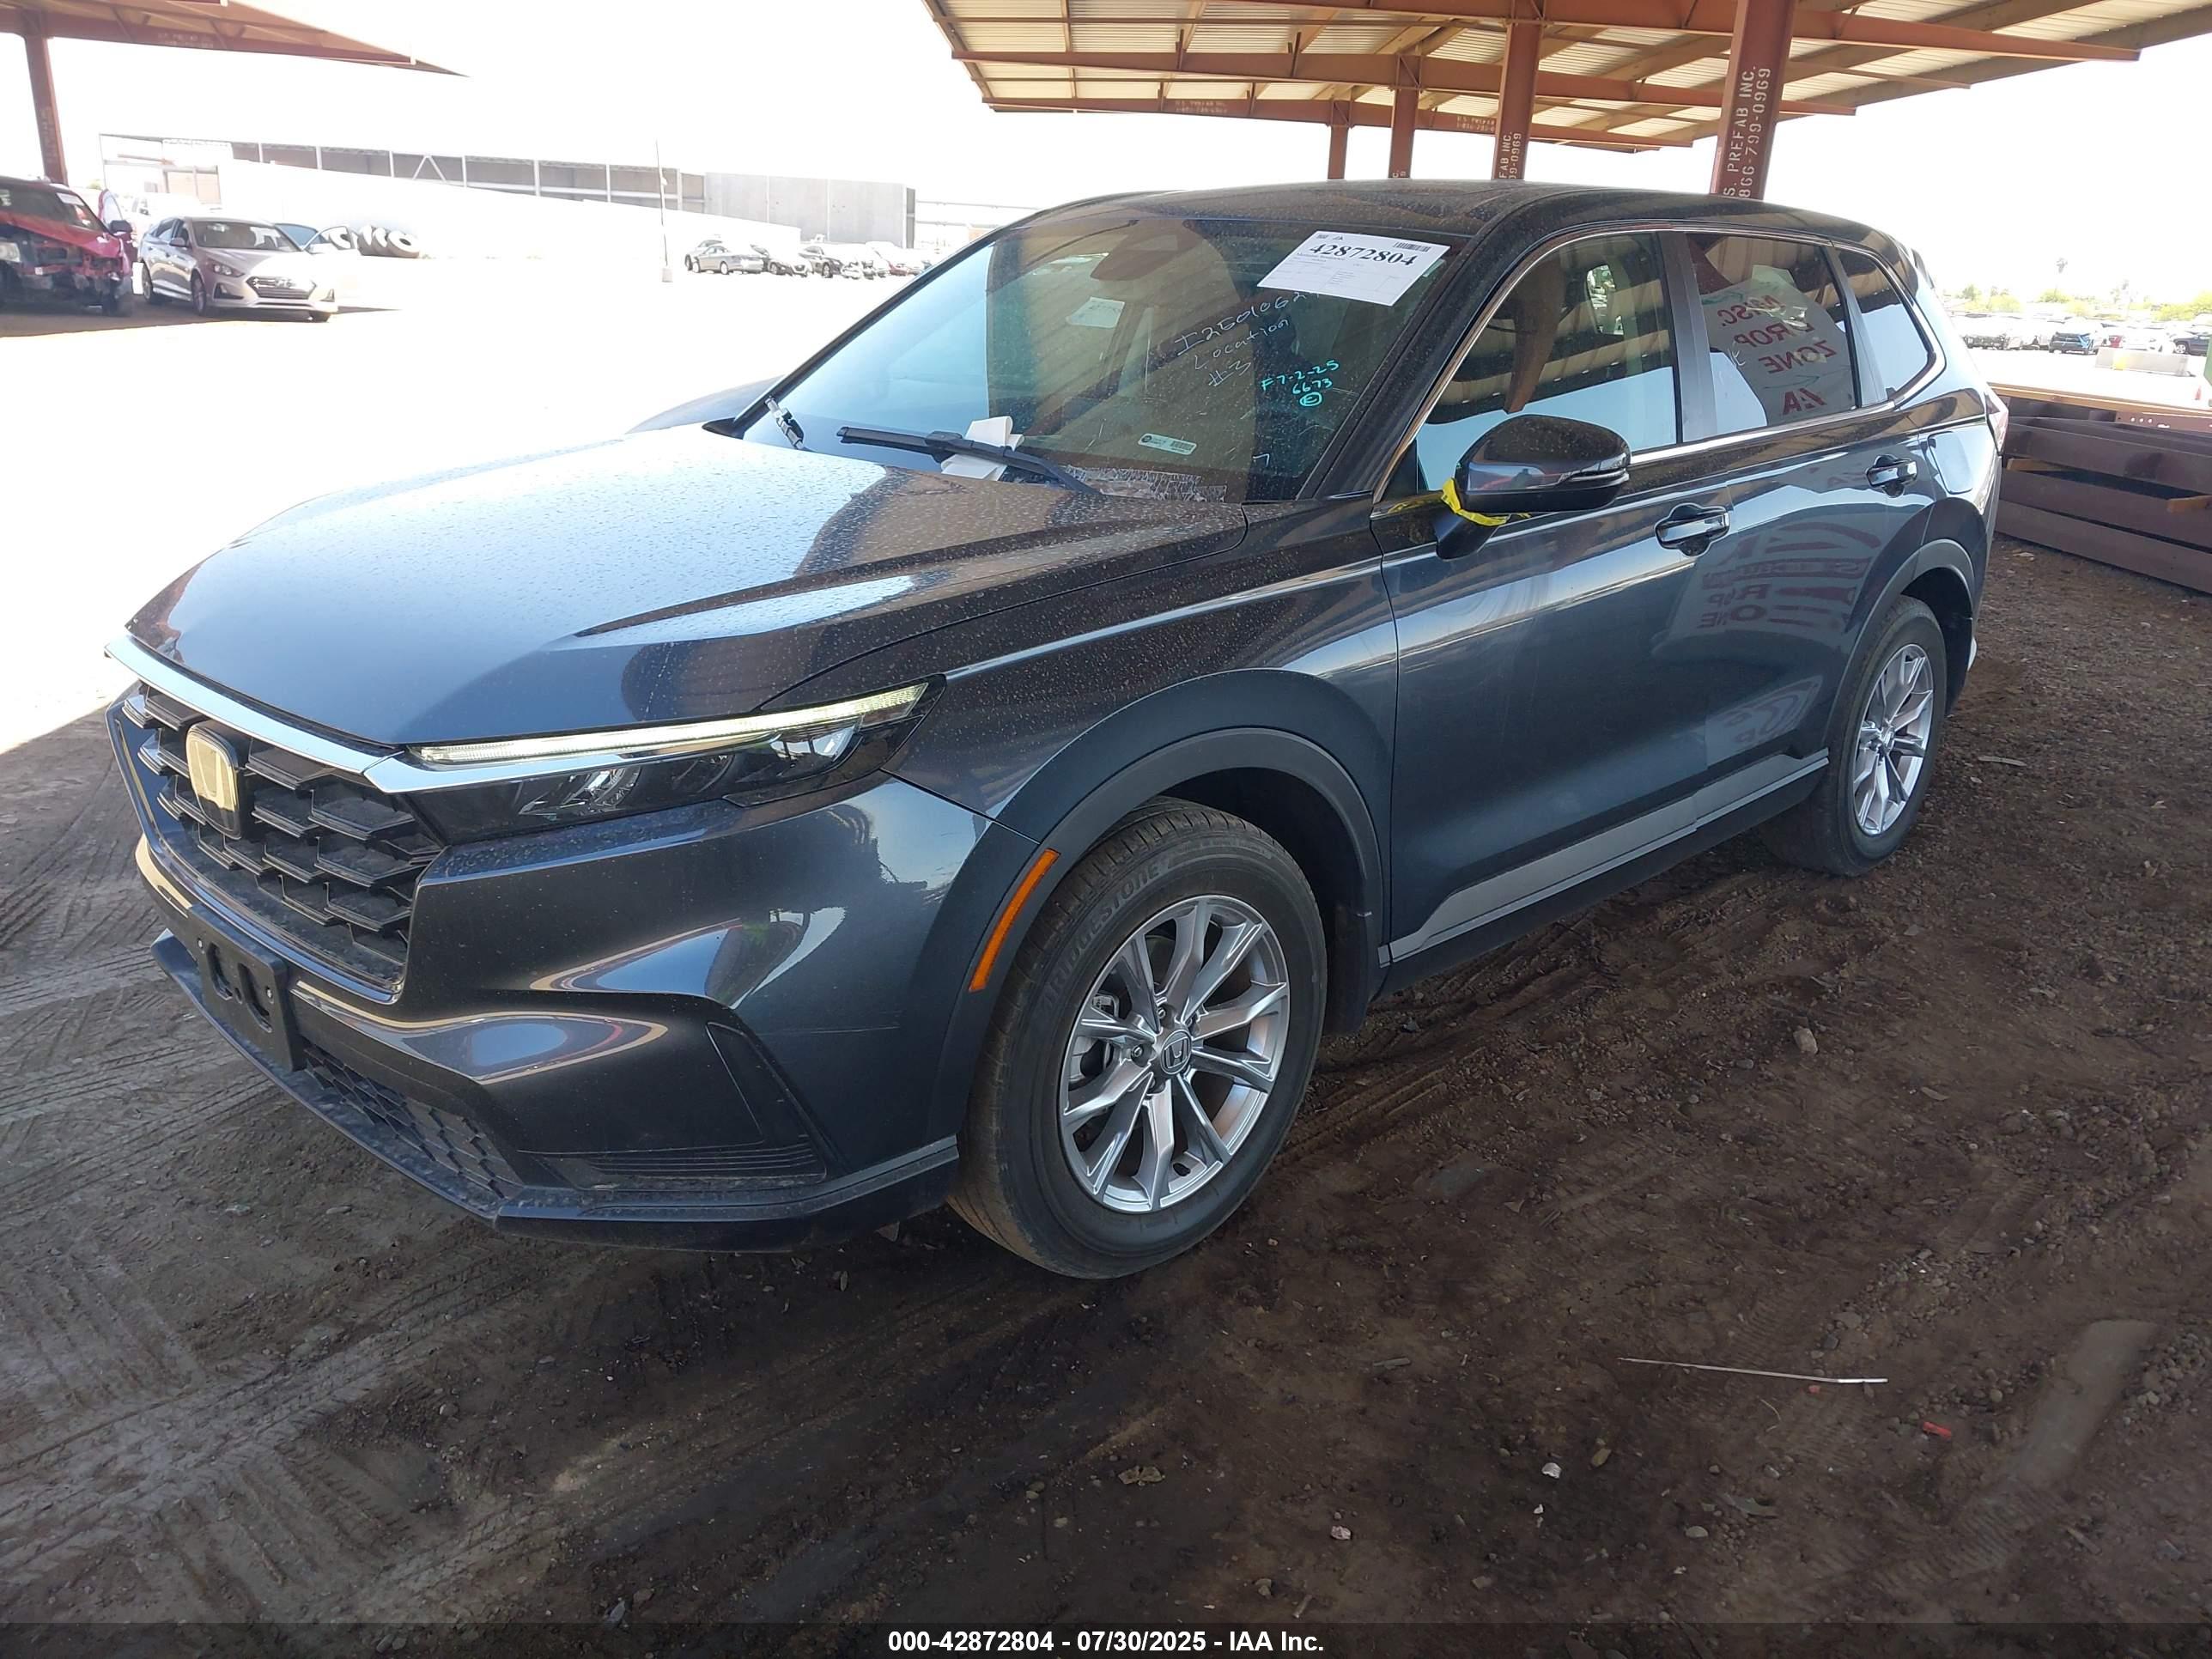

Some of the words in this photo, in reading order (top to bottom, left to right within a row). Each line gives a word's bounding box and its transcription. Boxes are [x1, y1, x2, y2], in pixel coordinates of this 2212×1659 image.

[1727, 106, 1748, 172] PREFAB
[1739, 66, 1756, 98] INC.
[1502, 131, 1513, 152] INC.
[1310, 243, 1418, 266] 42872804
[1194, 319, 1289, 370] Location
[1292, 378, 1333, 394] 6673
